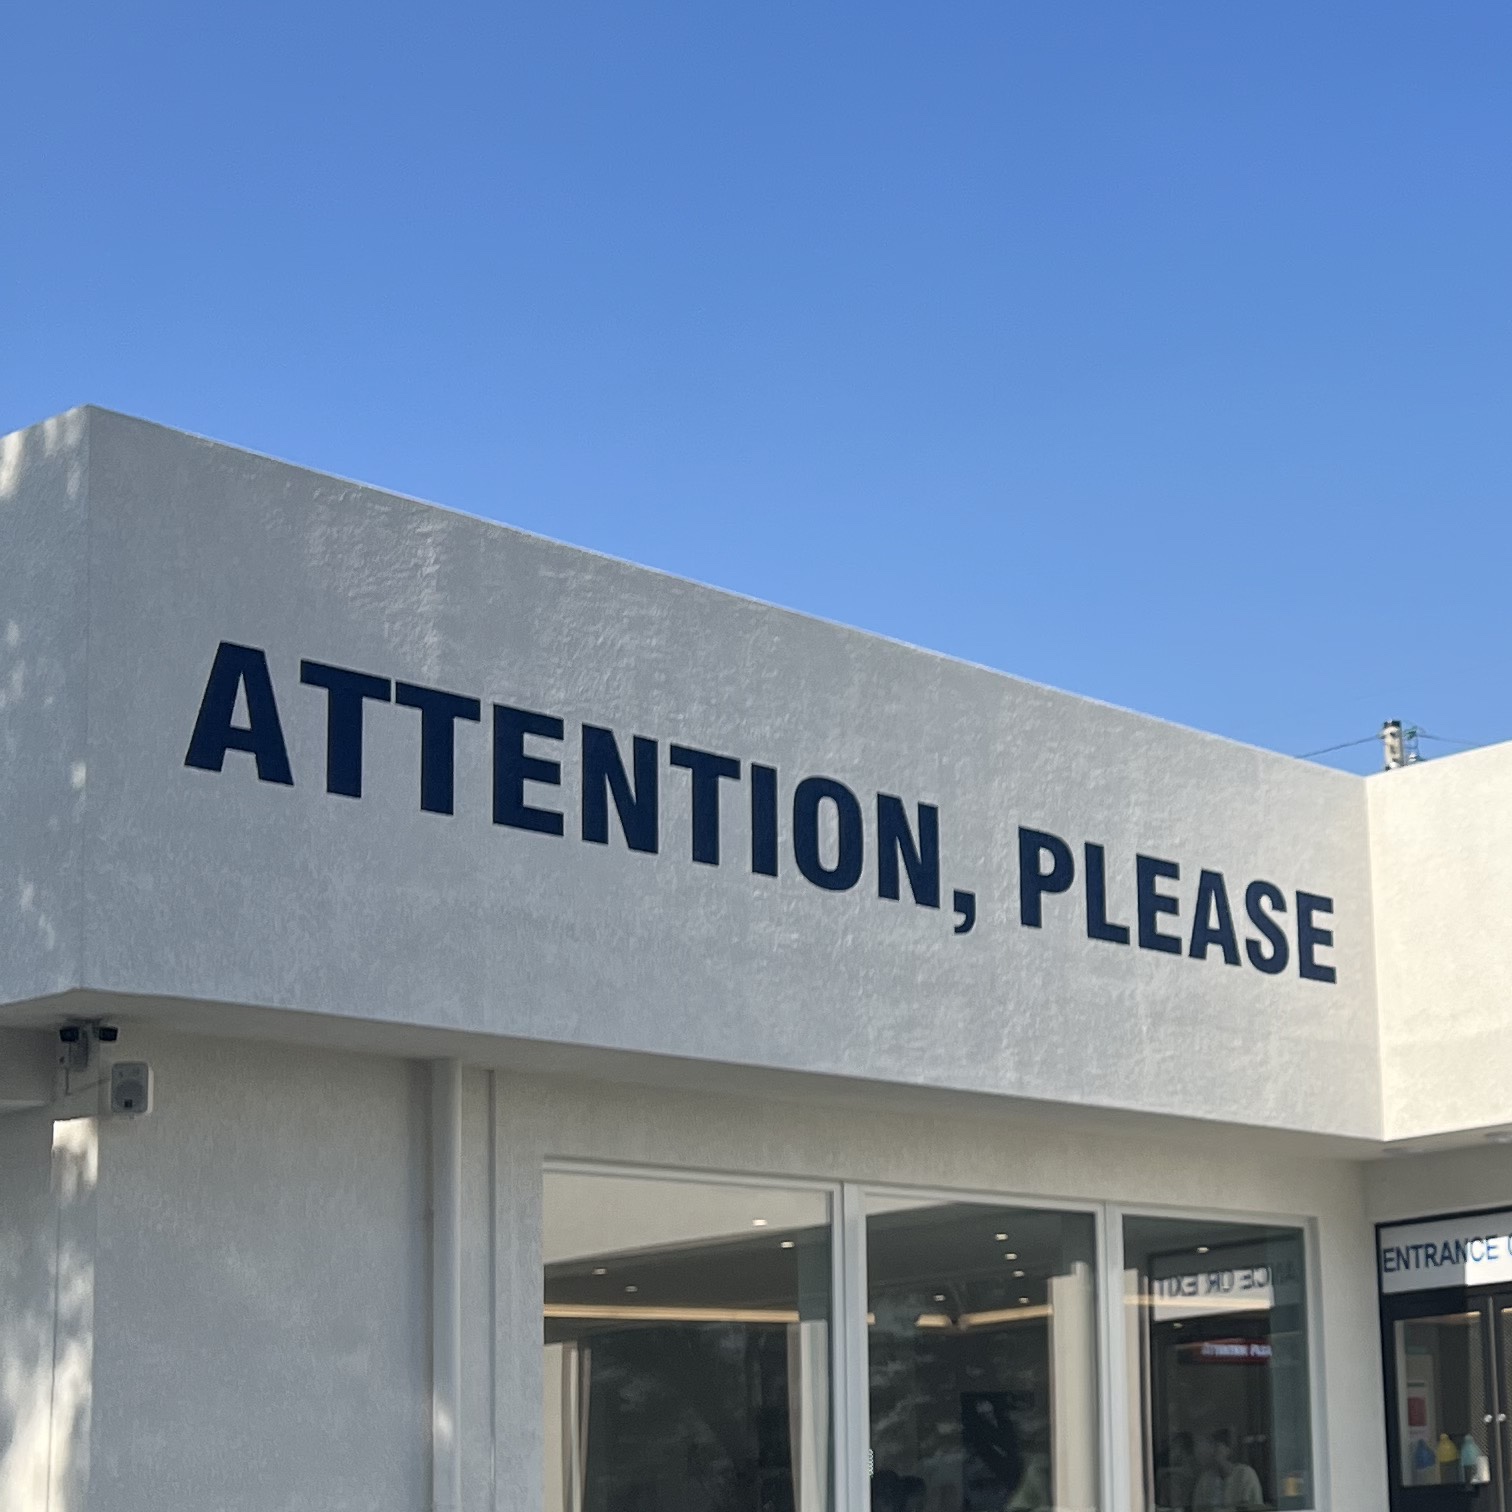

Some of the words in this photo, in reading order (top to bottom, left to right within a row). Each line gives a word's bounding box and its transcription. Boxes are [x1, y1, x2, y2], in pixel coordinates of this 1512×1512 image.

[184, 640, 977, 936] ATTENTION,
[1018, 826, 1338, 985] PLEASE
[1383, 1234, 1500, 1273] ENTRANCE
